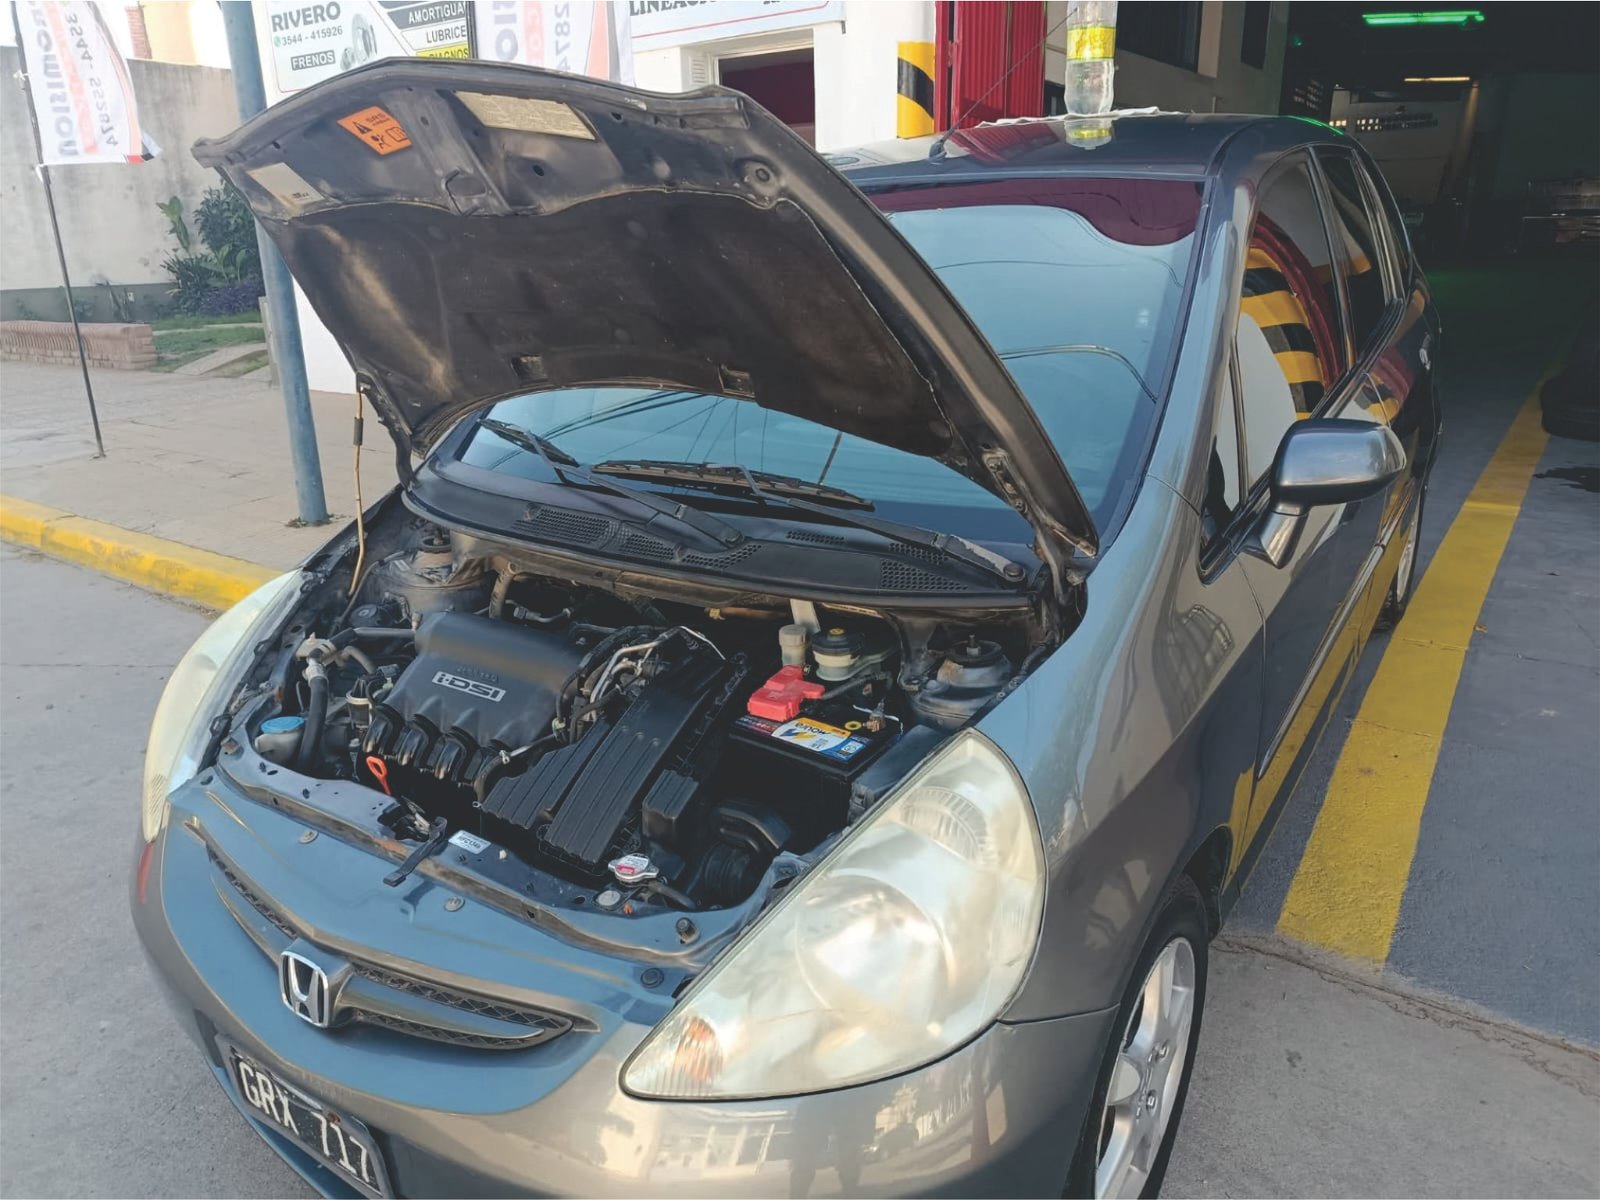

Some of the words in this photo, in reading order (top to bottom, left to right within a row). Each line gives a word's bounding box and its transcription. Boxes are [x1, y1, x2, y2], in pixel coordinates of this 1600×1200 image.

[271, 1, 341, 32] RIVERO
[408, 2, 465, 24] AMORTIGUA
[282, 33, 303, 46] 3544
[310, 25, 343, 40] 415926
[426, 25, 467, 43] LUBRICE
[292, 51, 335, 69] FRENOS
[239, 1061, 299, 1135] GRX
[311, 1111, 371, 1183] 717
